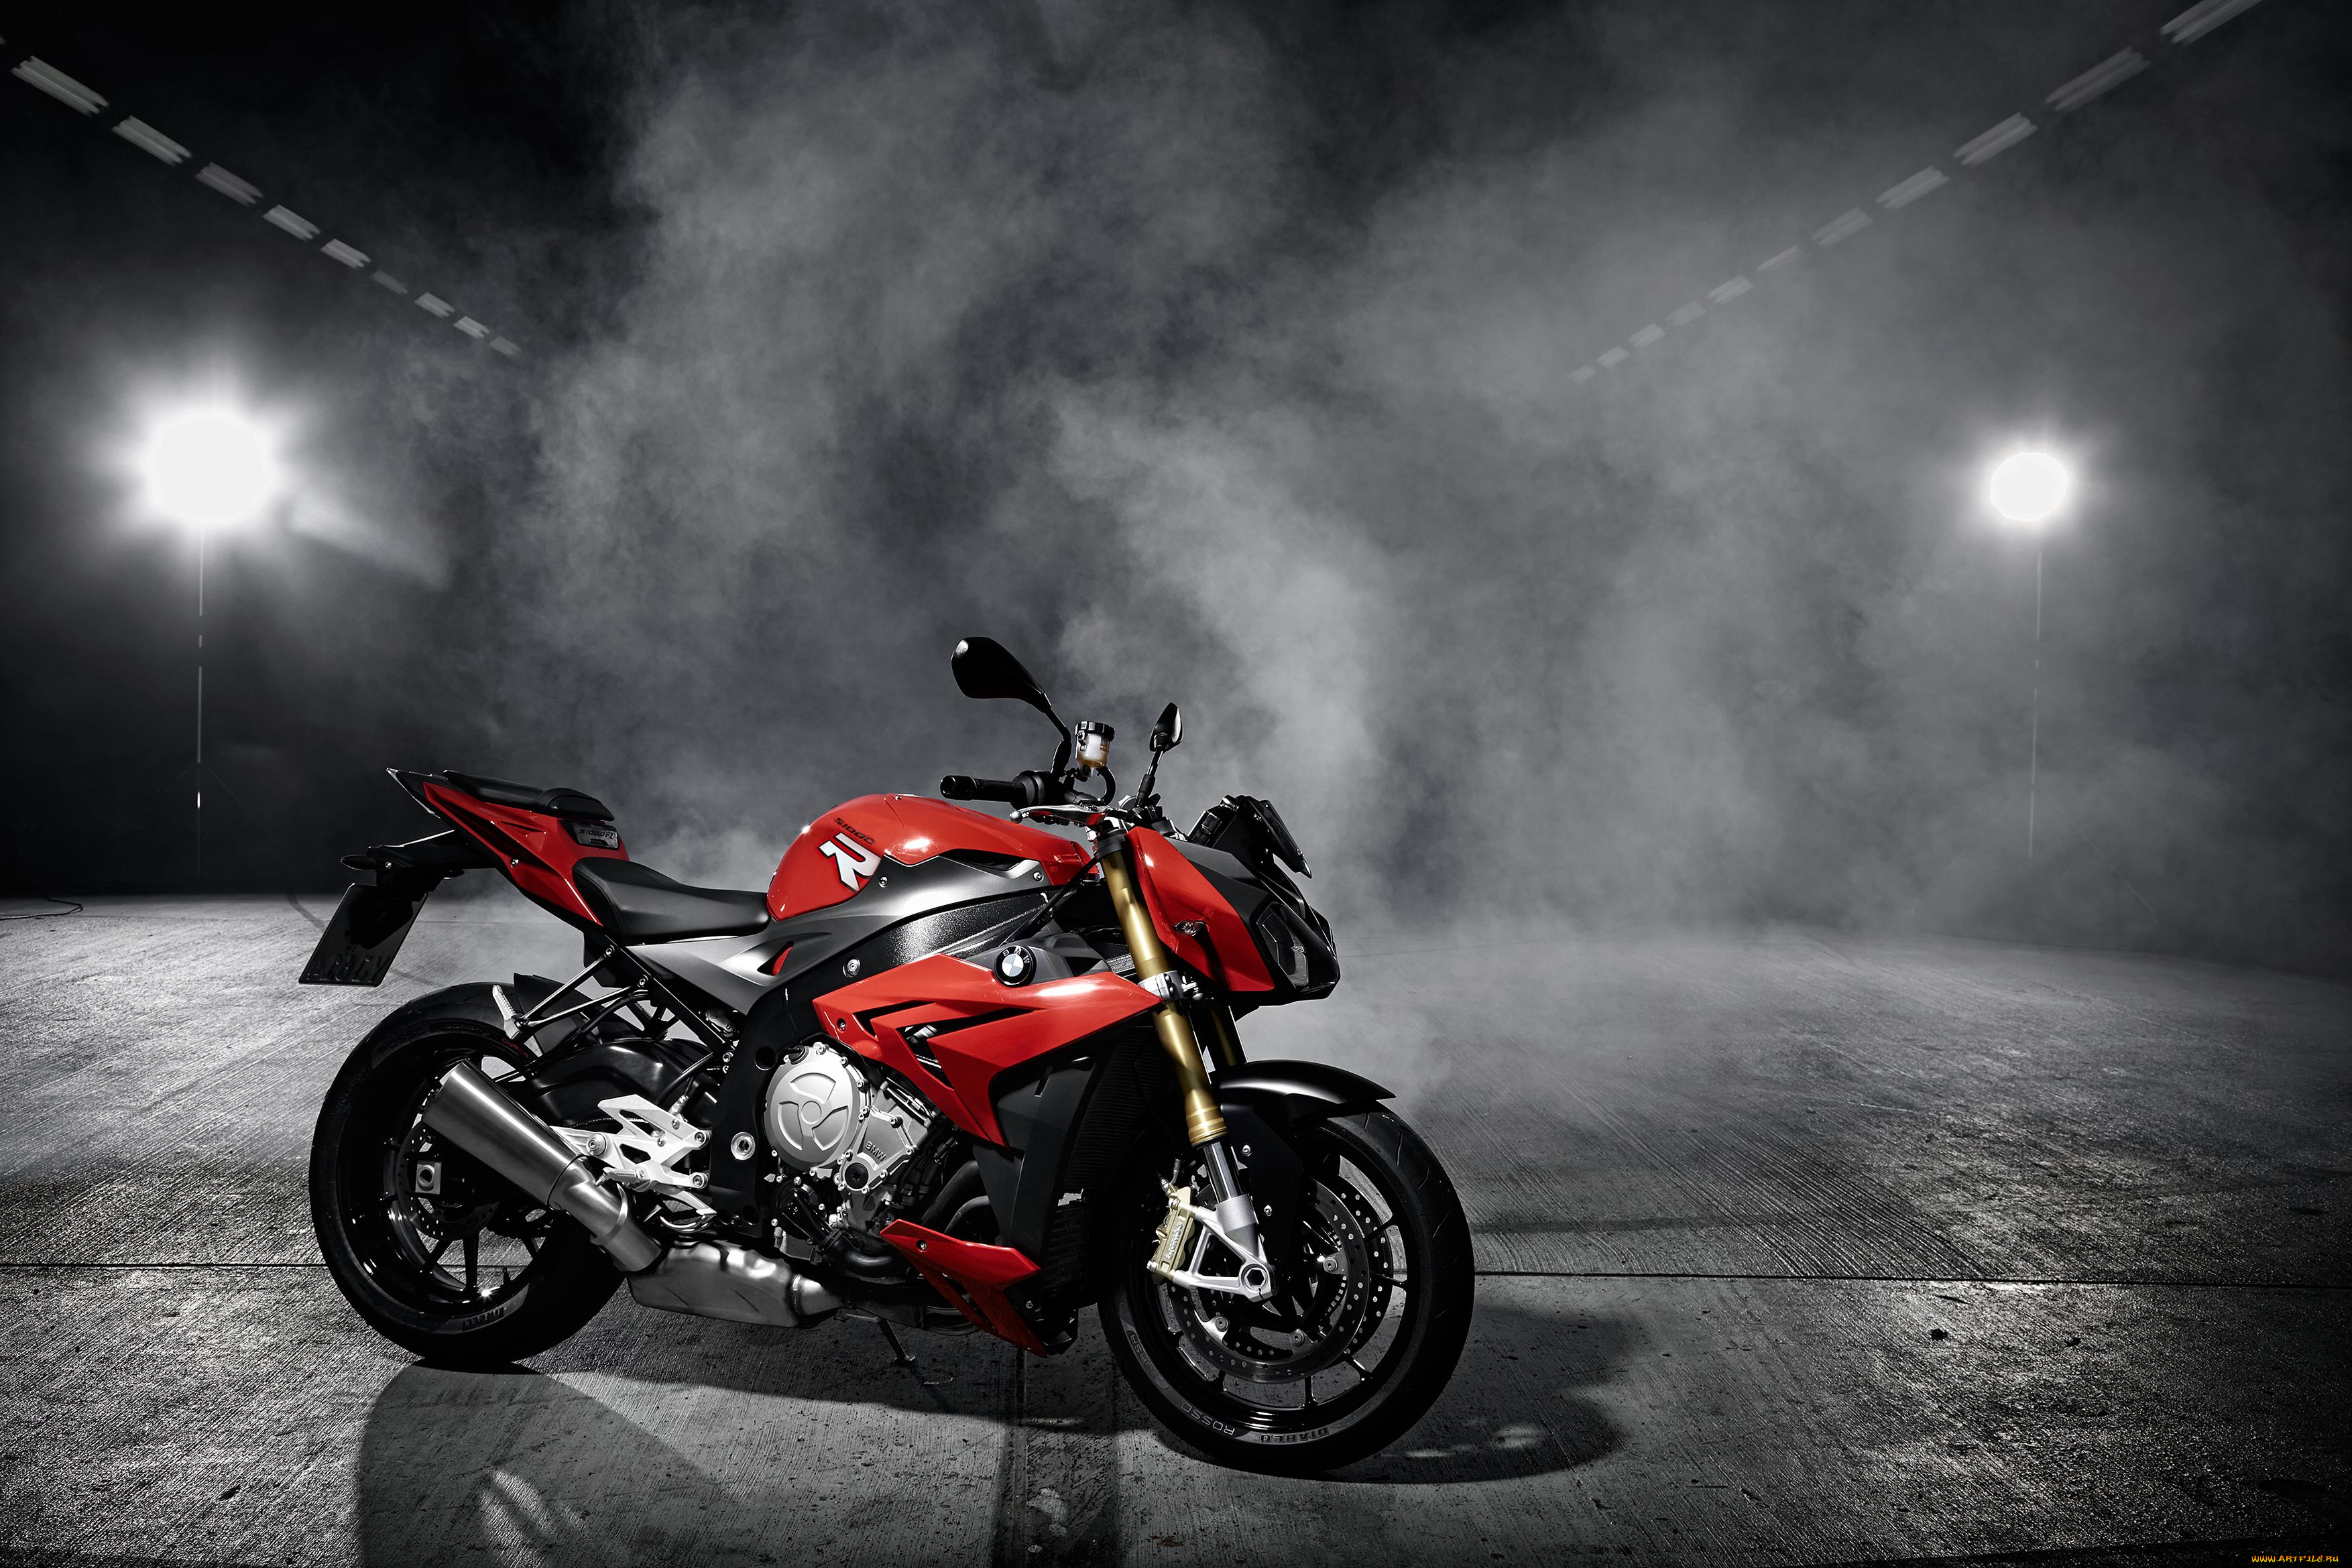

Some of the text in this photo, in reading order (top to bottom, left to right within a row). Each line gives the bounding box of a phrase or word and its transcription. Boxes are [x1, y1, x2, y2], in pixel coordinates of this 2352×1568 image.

[834, 817, 876, 845] S1000
[818, 831, 882, 893] R
[1002, 946, 1030, 963] BMW
[866, 1141, 886, 1161] BMW
[1181, 1402, 1235, 1435] ROSSO
[1260, 1427, 1330, 1442] DIABLO
